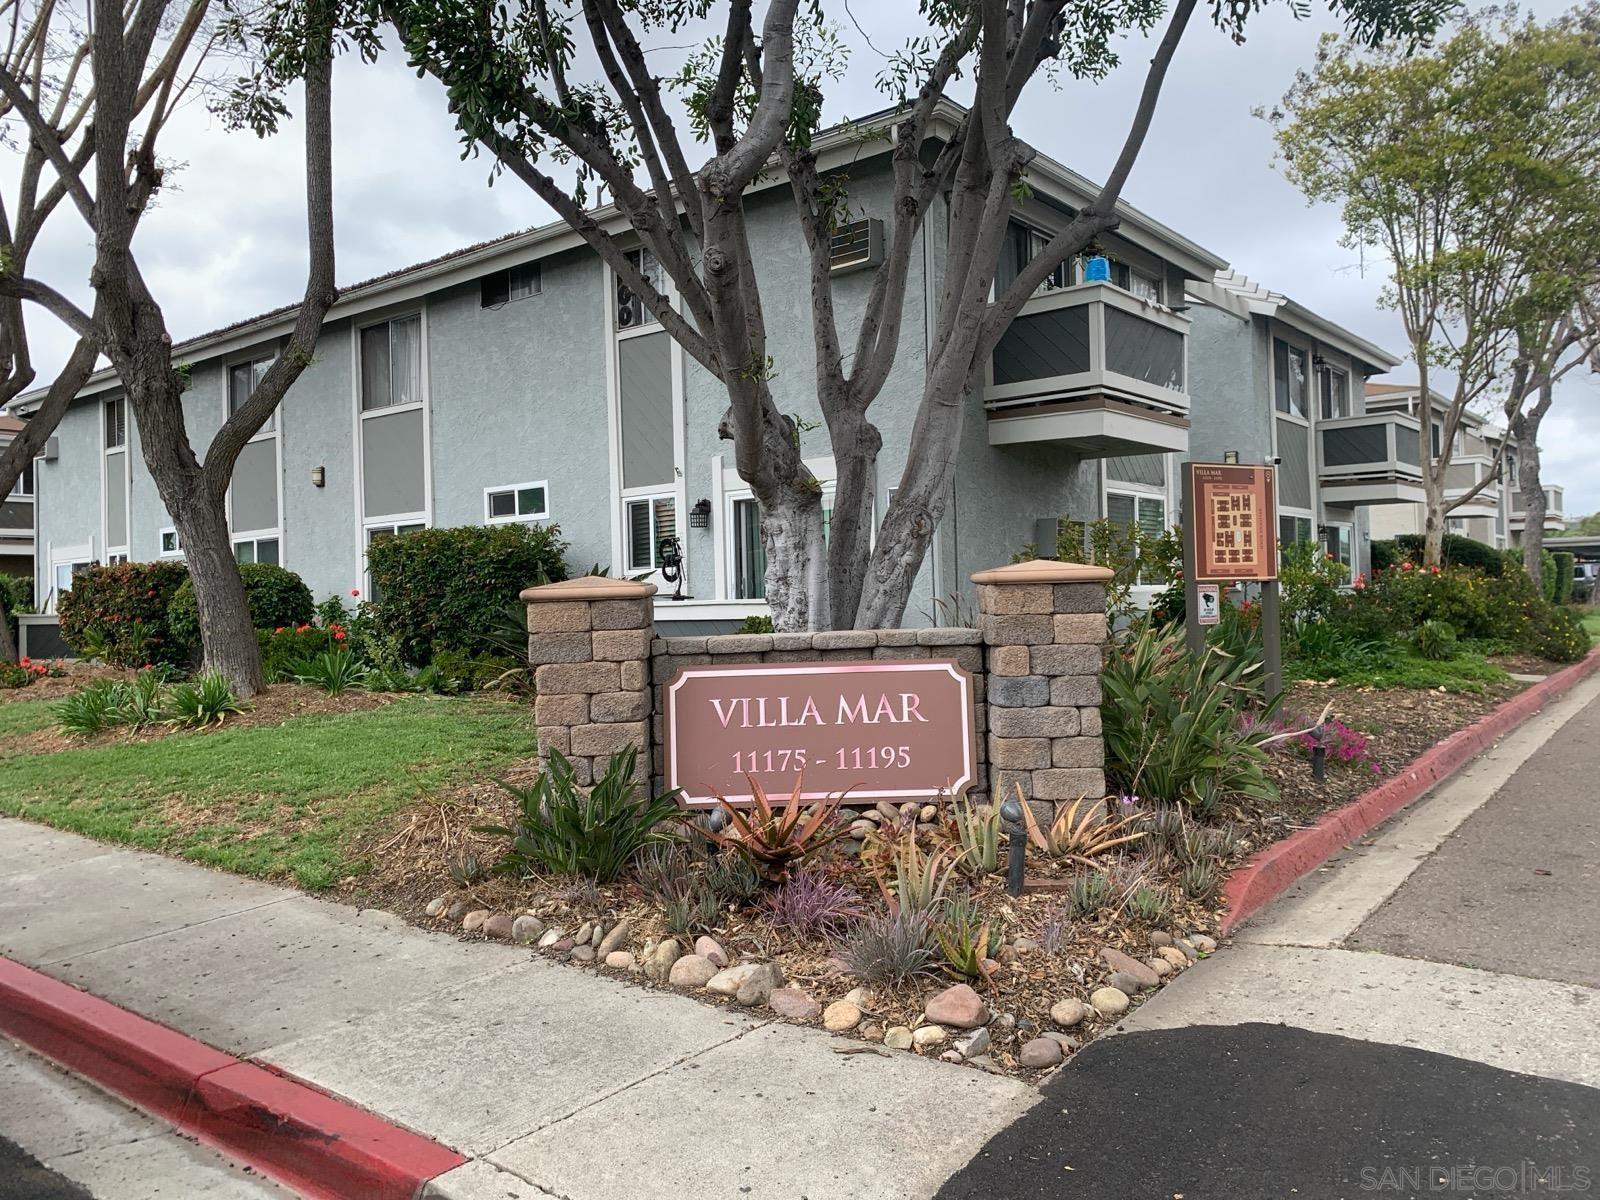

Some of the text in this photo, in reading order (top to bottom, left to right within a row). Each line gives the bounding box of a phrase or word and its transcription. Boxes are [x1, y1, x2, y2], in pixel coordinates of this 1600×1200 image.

[709, 693, 929, 728] VILLA MAR
[732, 749, 807, 773] 11175
[836, 746, 911, 770] 11195
